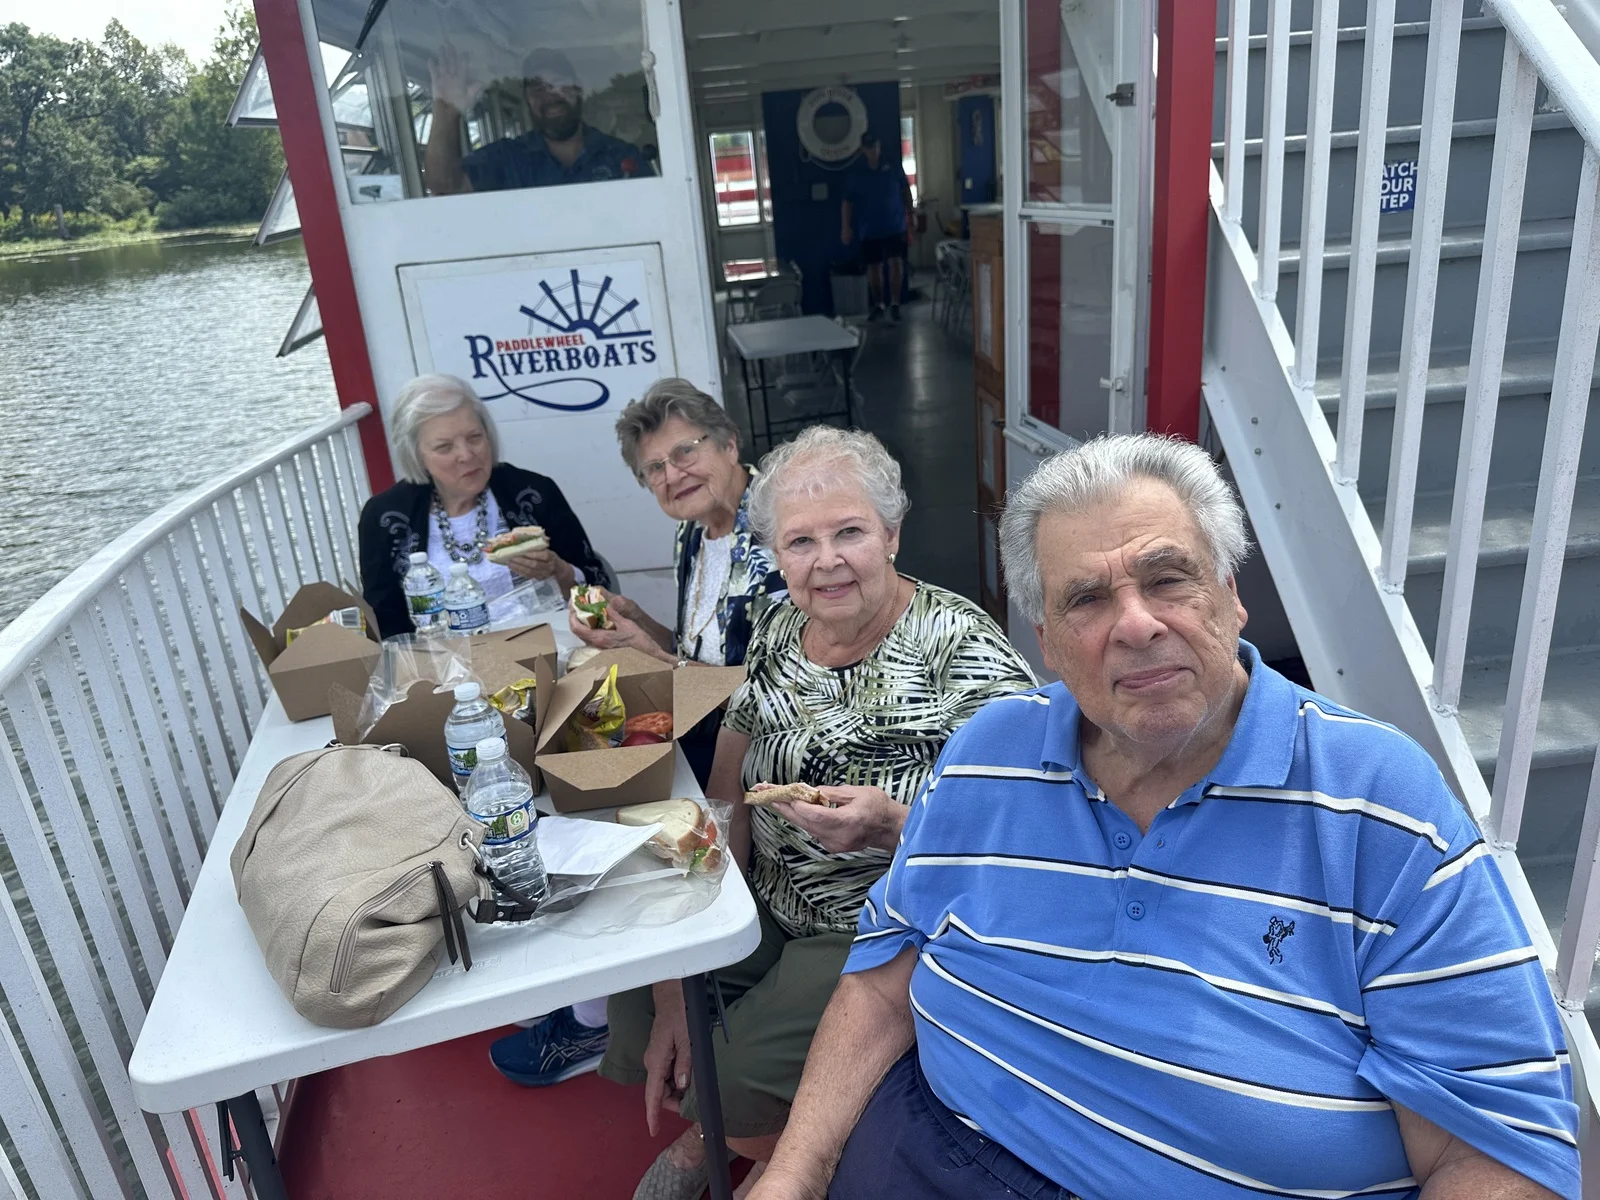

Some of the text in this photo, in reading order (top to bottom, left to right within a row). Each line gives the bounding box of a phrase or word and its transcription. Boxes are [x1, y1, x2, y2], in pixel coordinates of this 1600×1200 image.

[1383, 162, 1418, 178] ATCH
[1381, 178, 1413, 194] OUR
[1381, 193, 1409, 209] TEP
[496, 334, 586, 353] PADDLEWHEEL
[464, 335, 657, 379] RIVERBOATS
